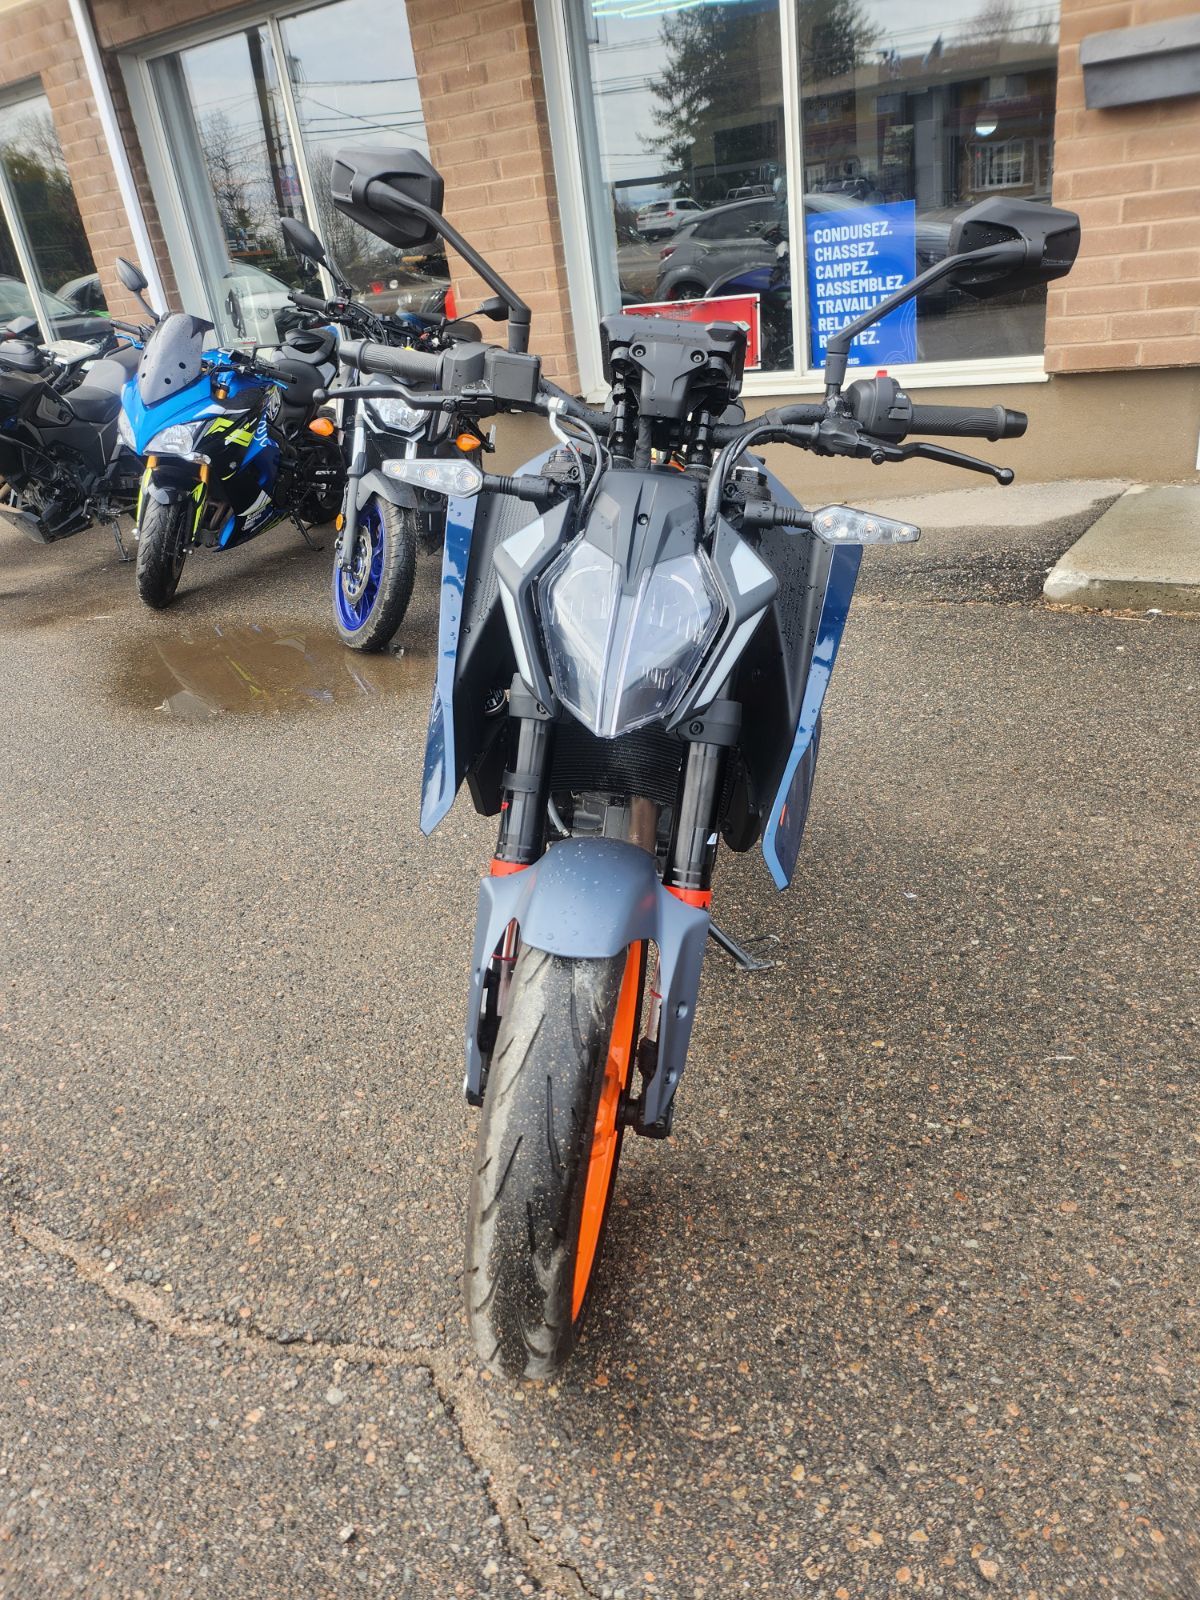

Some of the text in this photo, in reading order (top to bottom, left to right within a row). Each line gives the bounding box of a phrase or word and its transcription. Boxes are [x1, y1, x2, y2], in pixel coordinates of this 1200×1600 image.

[814, 221, 893, 244] CONDUISEZ.
[815, 241, 879, 262] CHASSEZ.
[816, 260, 872, 280] CAMPEZ.
[817, 275, 907, 297] RASSEMBLEZ.
